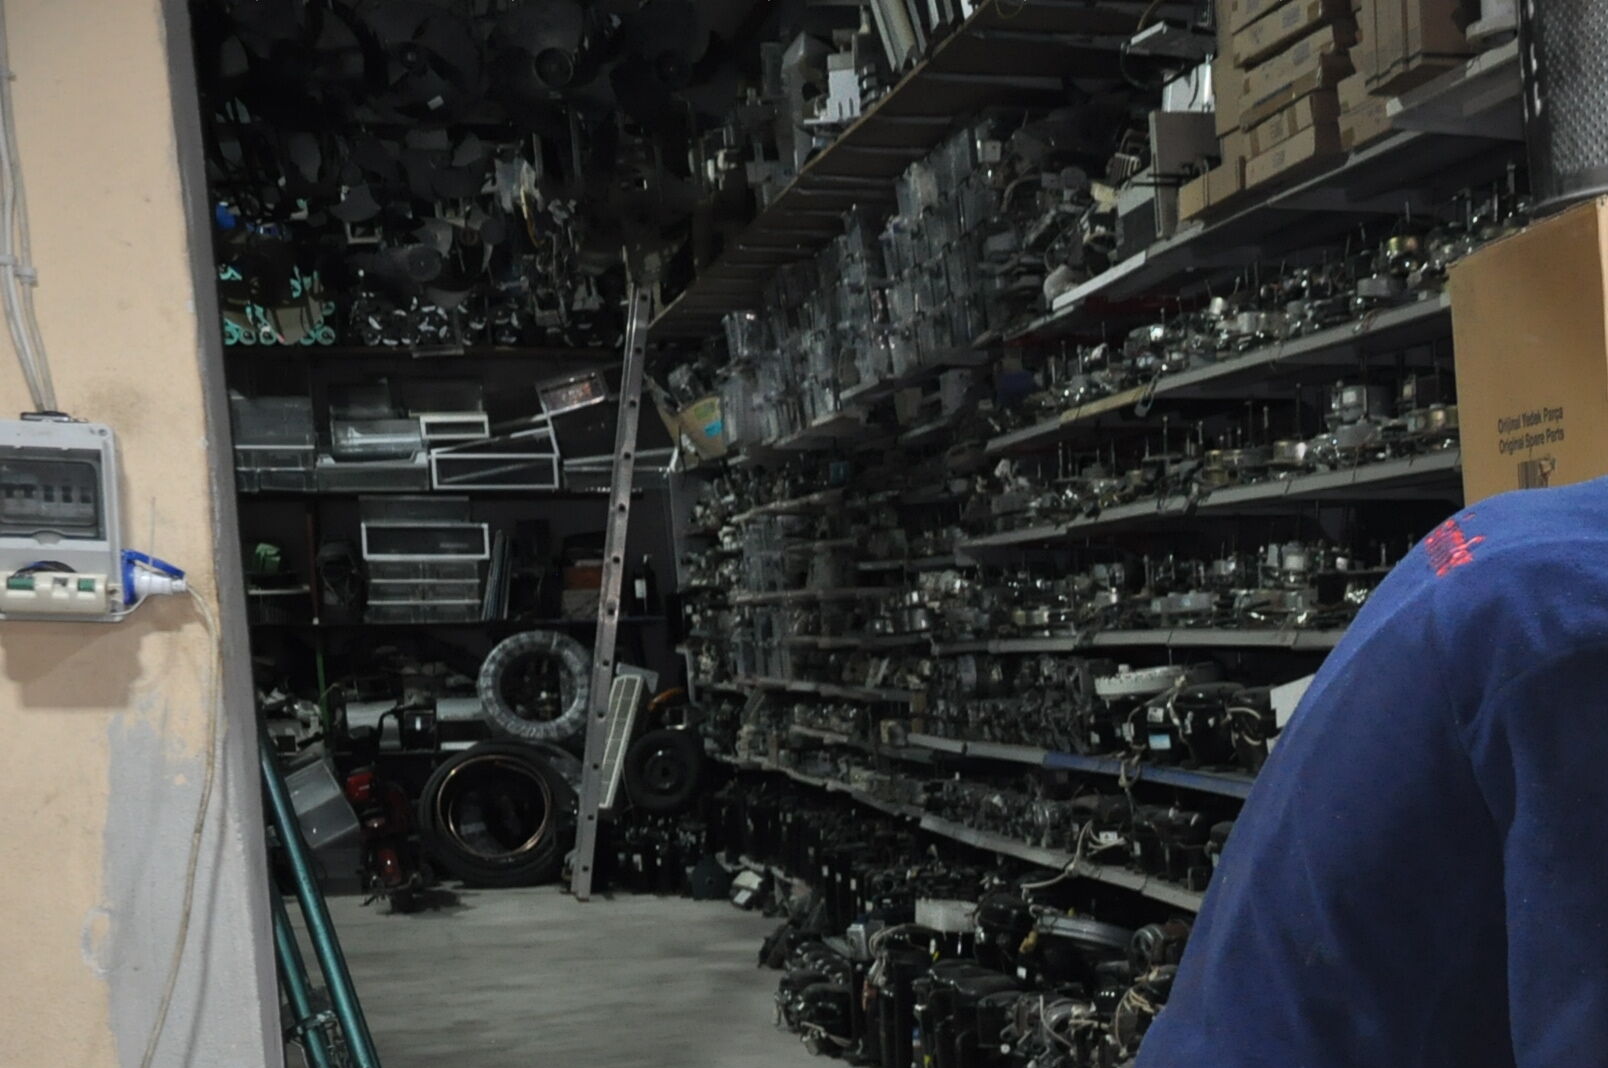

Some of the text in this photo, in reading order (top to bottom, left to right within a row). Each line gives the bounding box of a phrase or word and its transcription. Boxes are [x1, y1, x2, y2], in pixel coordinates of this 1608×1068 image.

[1499, 427, 1565, 456] Original Spare Parts
